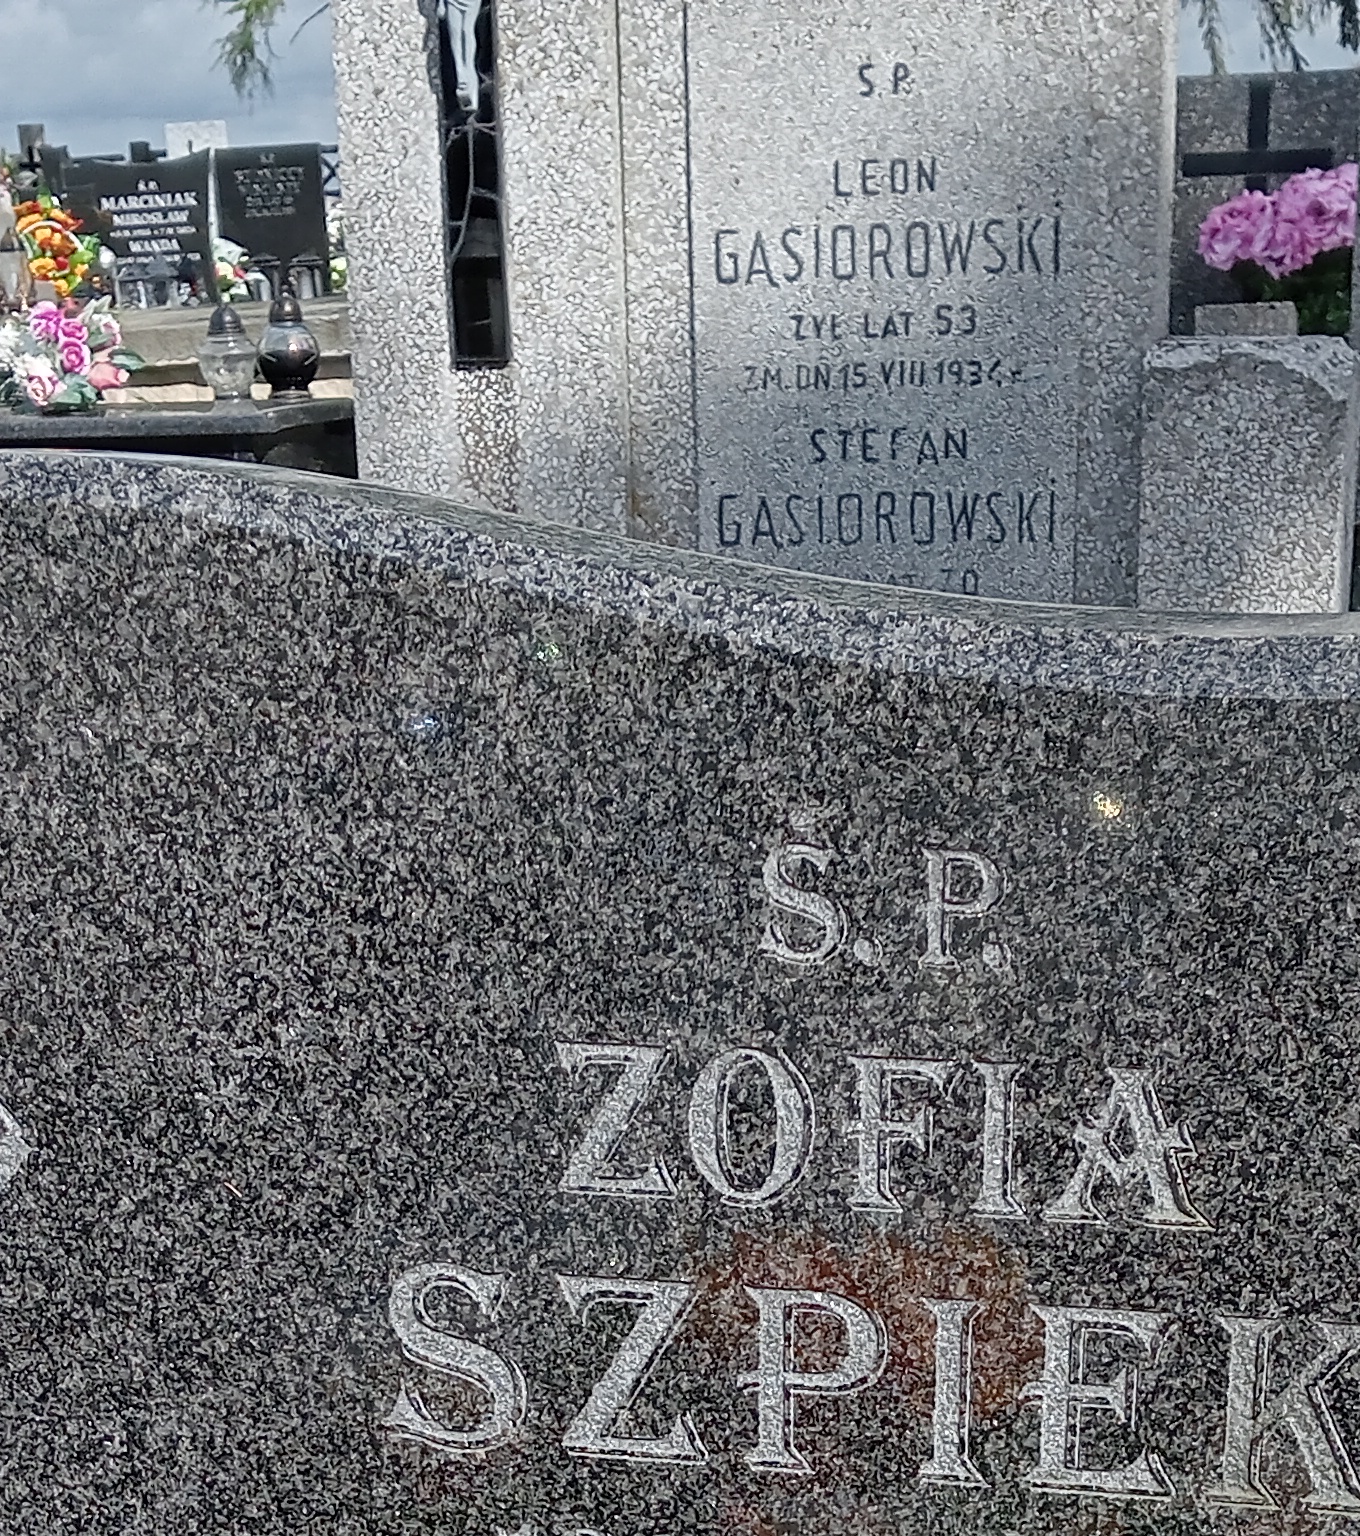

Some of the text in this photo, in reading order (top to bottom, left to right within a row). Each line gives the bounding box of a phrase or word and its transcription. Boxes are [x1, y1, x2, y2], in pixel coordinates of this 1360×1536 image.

[831, 157, 938, 198] LEON
[862, 311, 916, 340] LAT
[935, 304, 979, 336] 53
[809, 427, 969, 466] STEFAN
[554, 1039, 1216, 1233] ZOFIA
